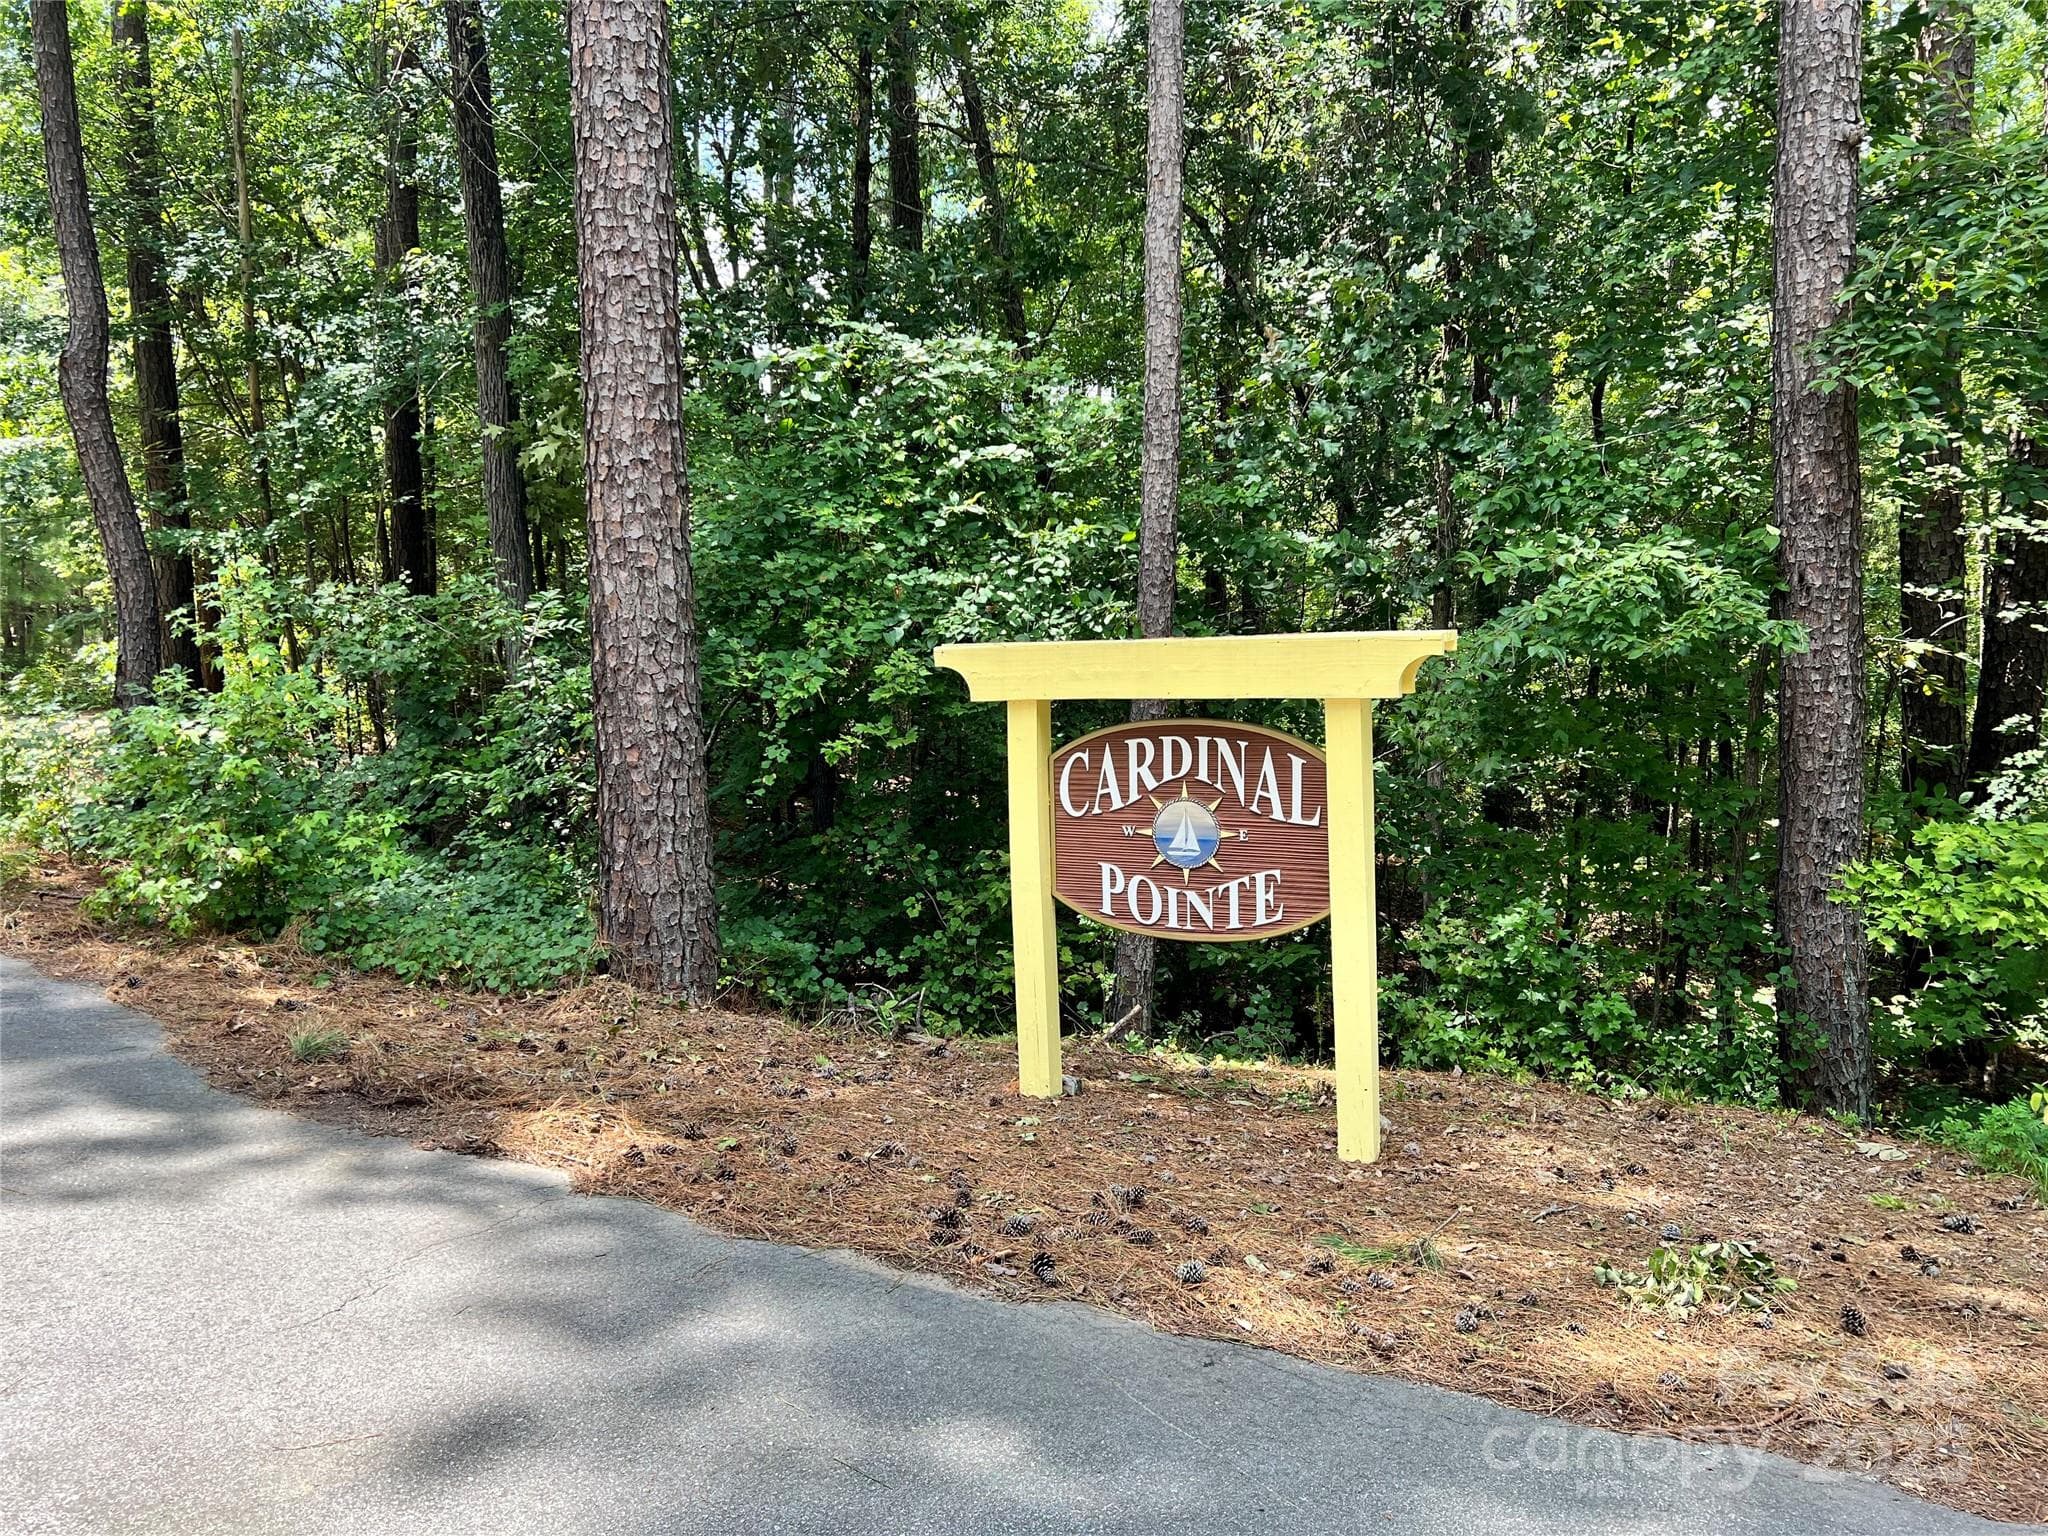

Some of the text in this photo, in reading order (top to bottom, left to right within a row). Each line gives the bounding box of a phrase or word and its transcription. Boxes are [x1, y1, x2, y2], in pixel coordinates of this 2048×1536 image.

[1059, 735, 1321, 826] CARDINAL
[1121, 825, 1136, 837] W
[1238, 829, 1249, 841] E
[1097, 861, 1284, 931] POINTE
